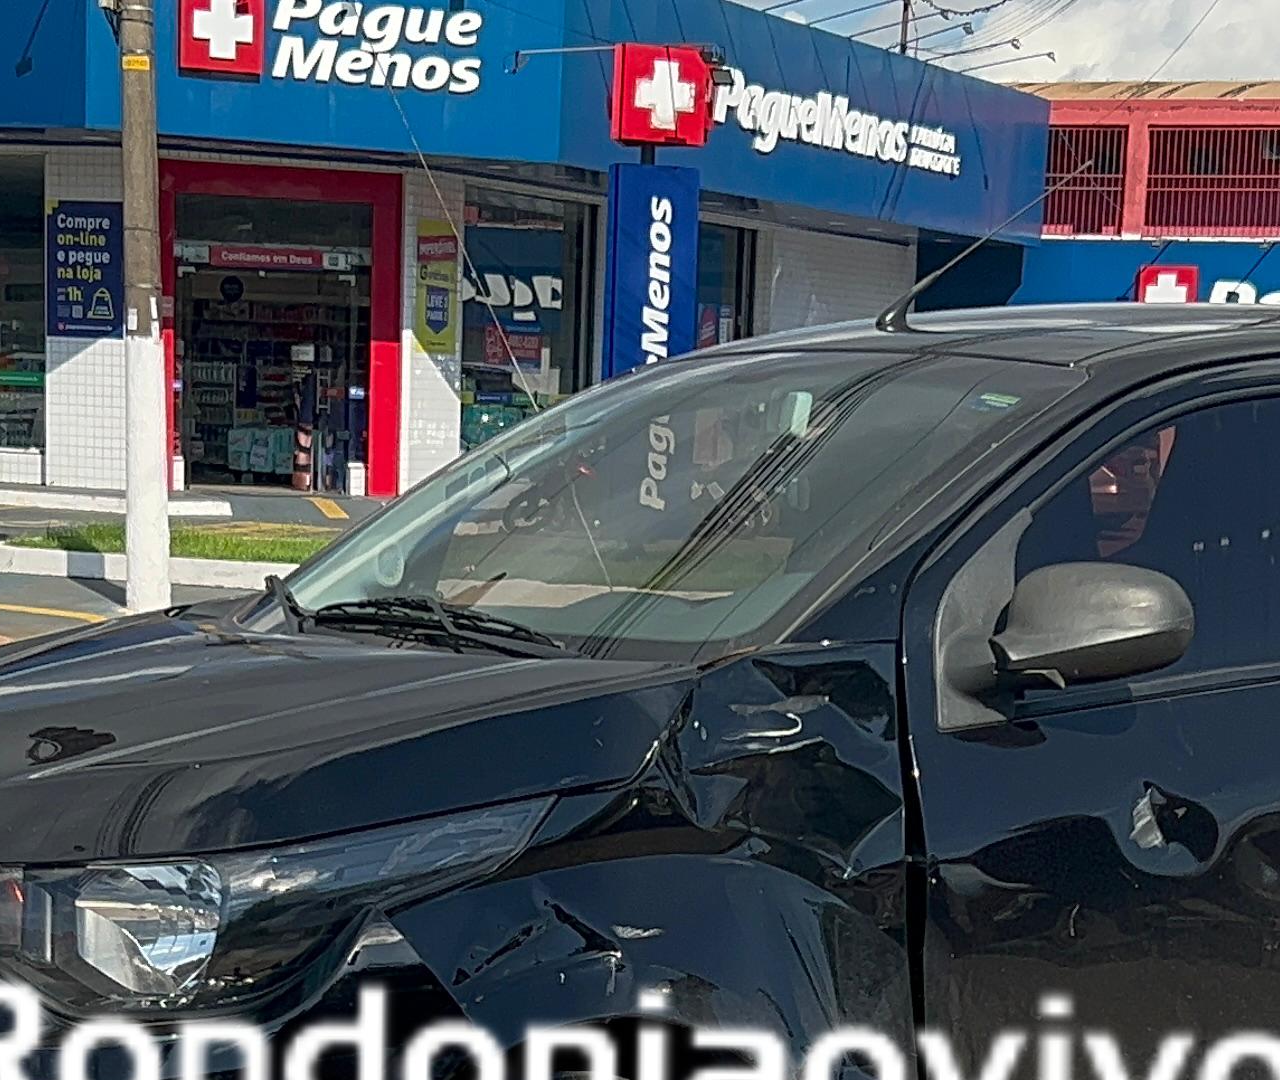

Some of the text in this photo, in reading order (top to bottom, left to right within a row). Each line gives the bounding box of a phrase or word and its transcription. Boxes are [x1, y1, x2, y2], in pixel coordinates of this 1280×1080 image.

[272, 0, 483, 53] Pague
[272, 35, 481, 93] Menos
[714, 65, 909, 163] PagueMenos
[57, 214, 111, 231] Compre
[57, 231, 106, 247] on-line
[57, 250, 111, 266] e pegue
[221, 251, 313, 265] Confiamos em Deus
[57, 266, 102, 283] na loja
